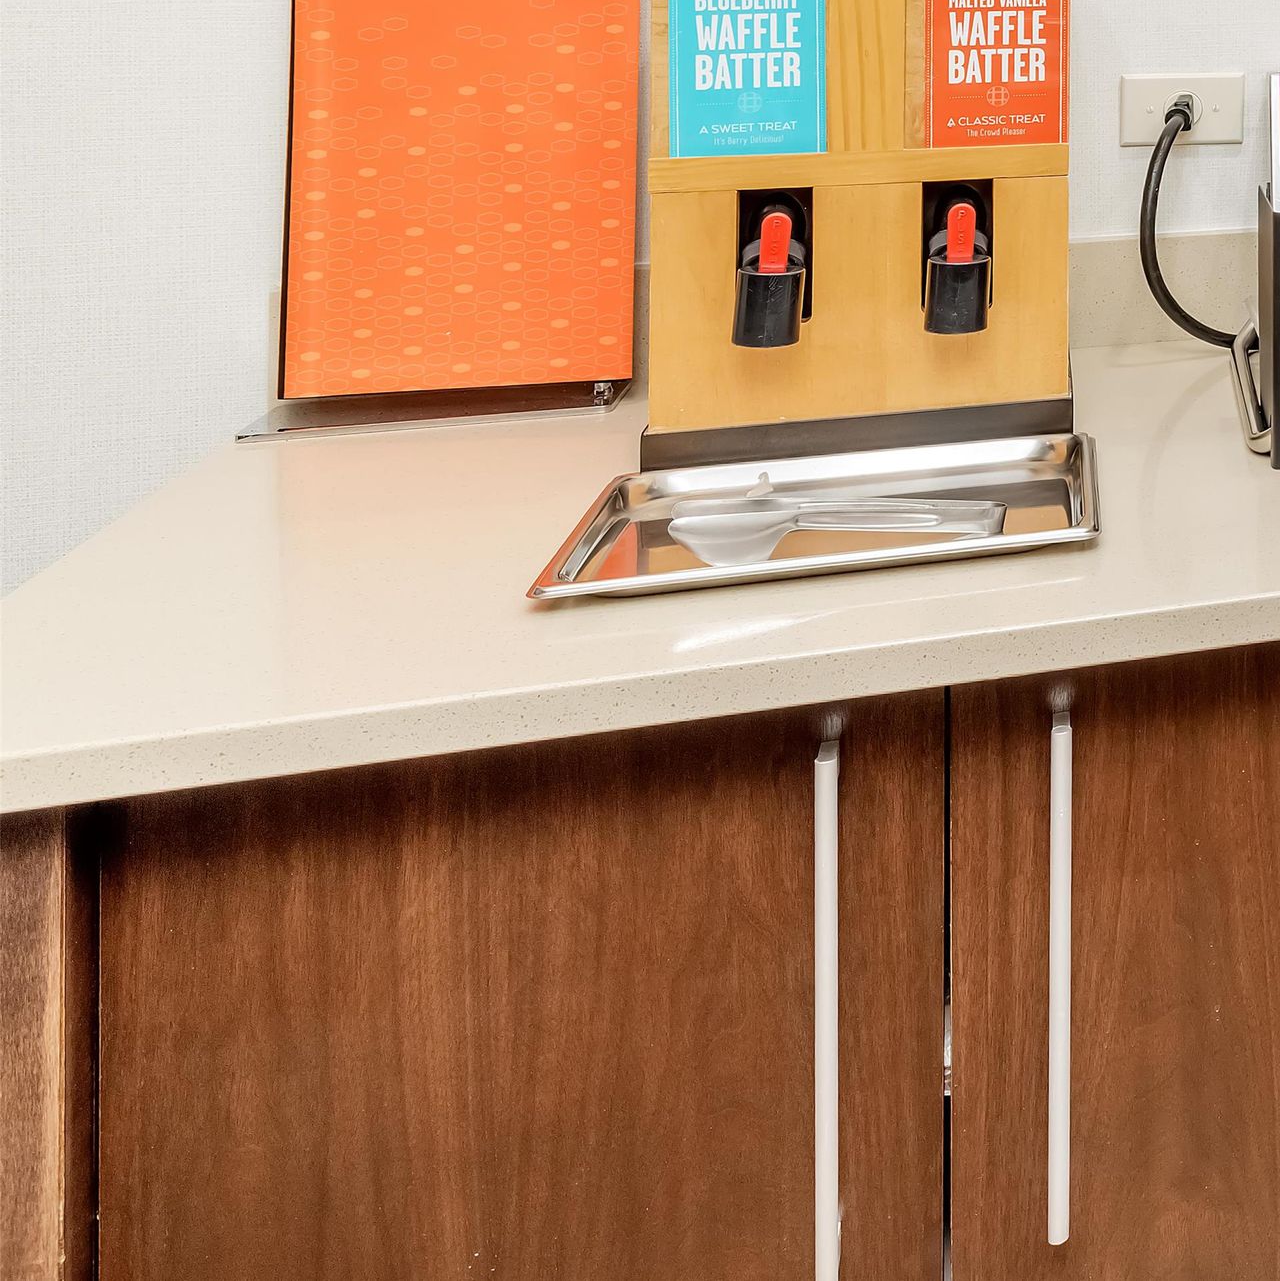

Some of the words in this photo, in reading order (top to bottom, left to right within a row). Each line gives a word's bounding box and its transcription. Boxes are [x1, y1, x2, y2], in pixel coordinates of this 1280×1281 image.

[695, 11, 802, 51] WAFFLE
[949, 9, 1047, 47] WAFFLE
[694, 50, 801, 91] BATTER
[947, 46, 1046, 85] BATTER
[699, 125, 709, 135] A
[711, 122, 755, 134] SWEET
[757, 120, 797, 132] TREAT
[946, 117, 956, 127] A
[958, 115, 1007, 126] CLASSIC
[1009, 113, 1046, 124] TREAT
